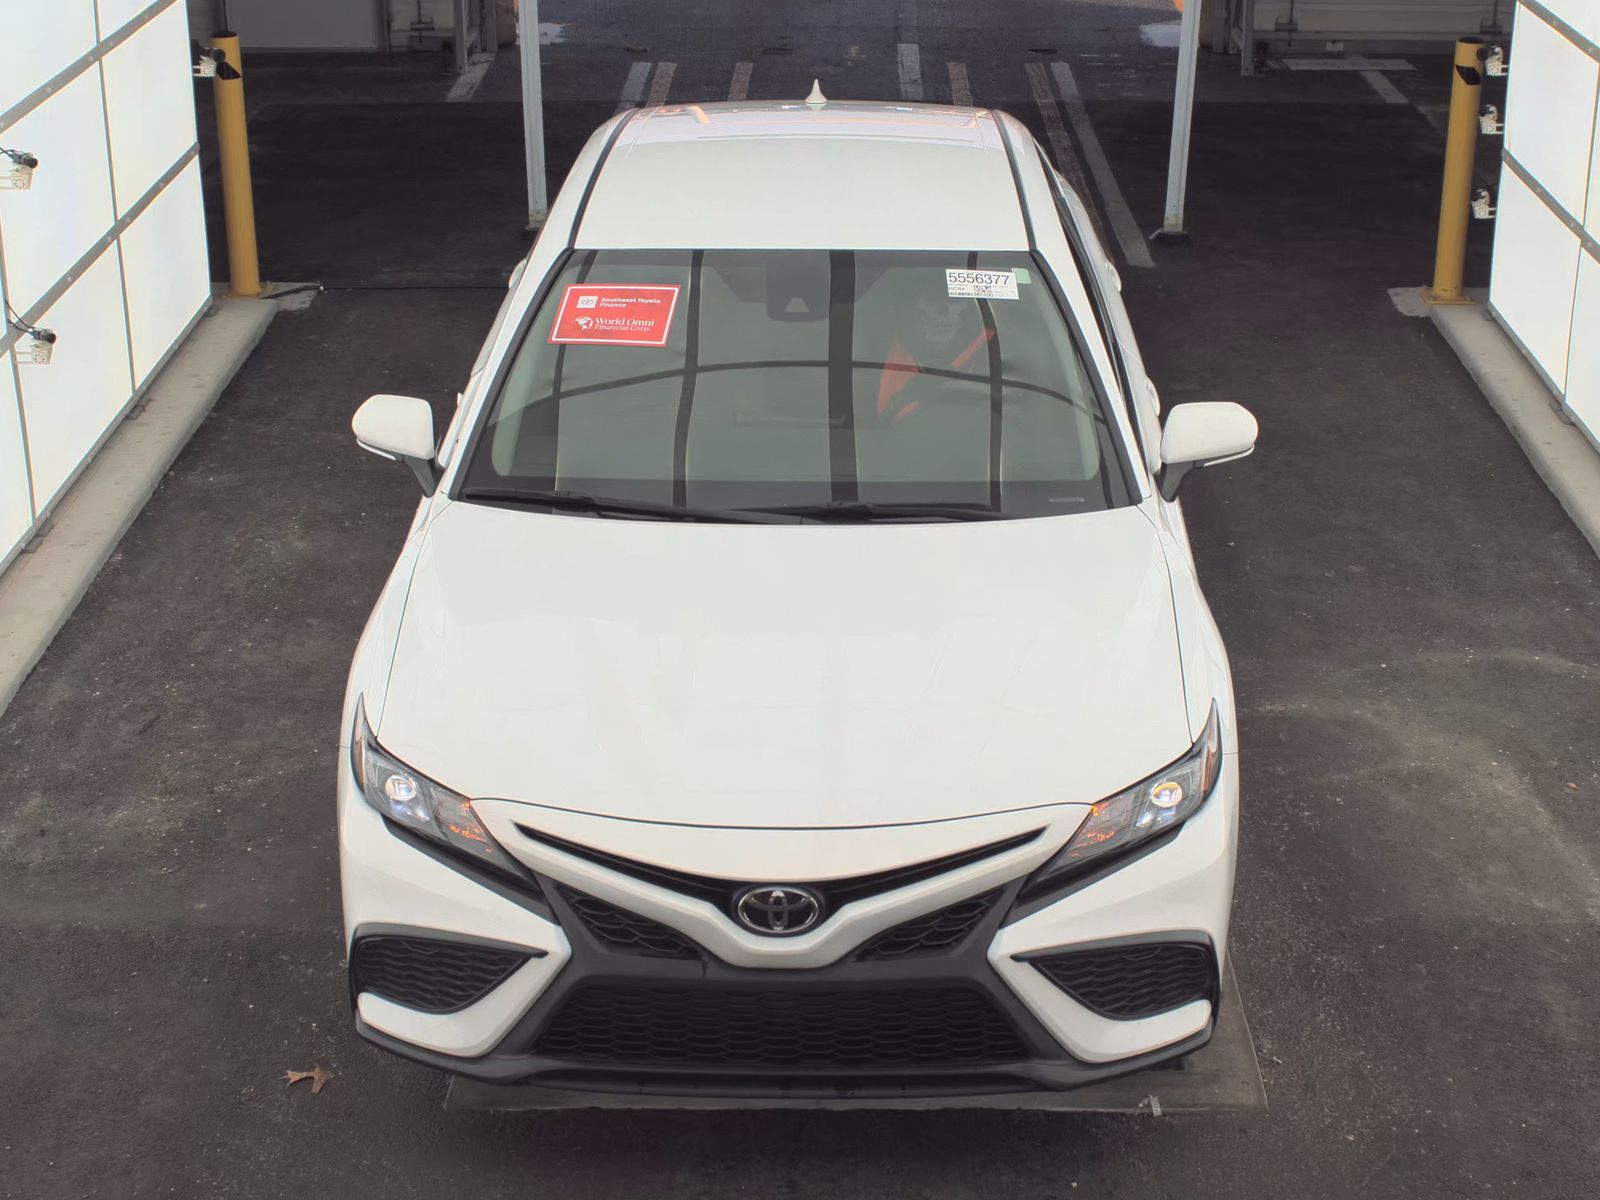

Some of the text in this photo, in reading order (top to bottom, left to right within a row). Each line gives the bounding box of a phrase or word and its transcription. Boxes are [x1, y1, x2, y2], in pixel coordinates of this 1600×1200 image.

[948, 272, 1010, 285] 5556377
[595, 317, 655, 327] World Omni
